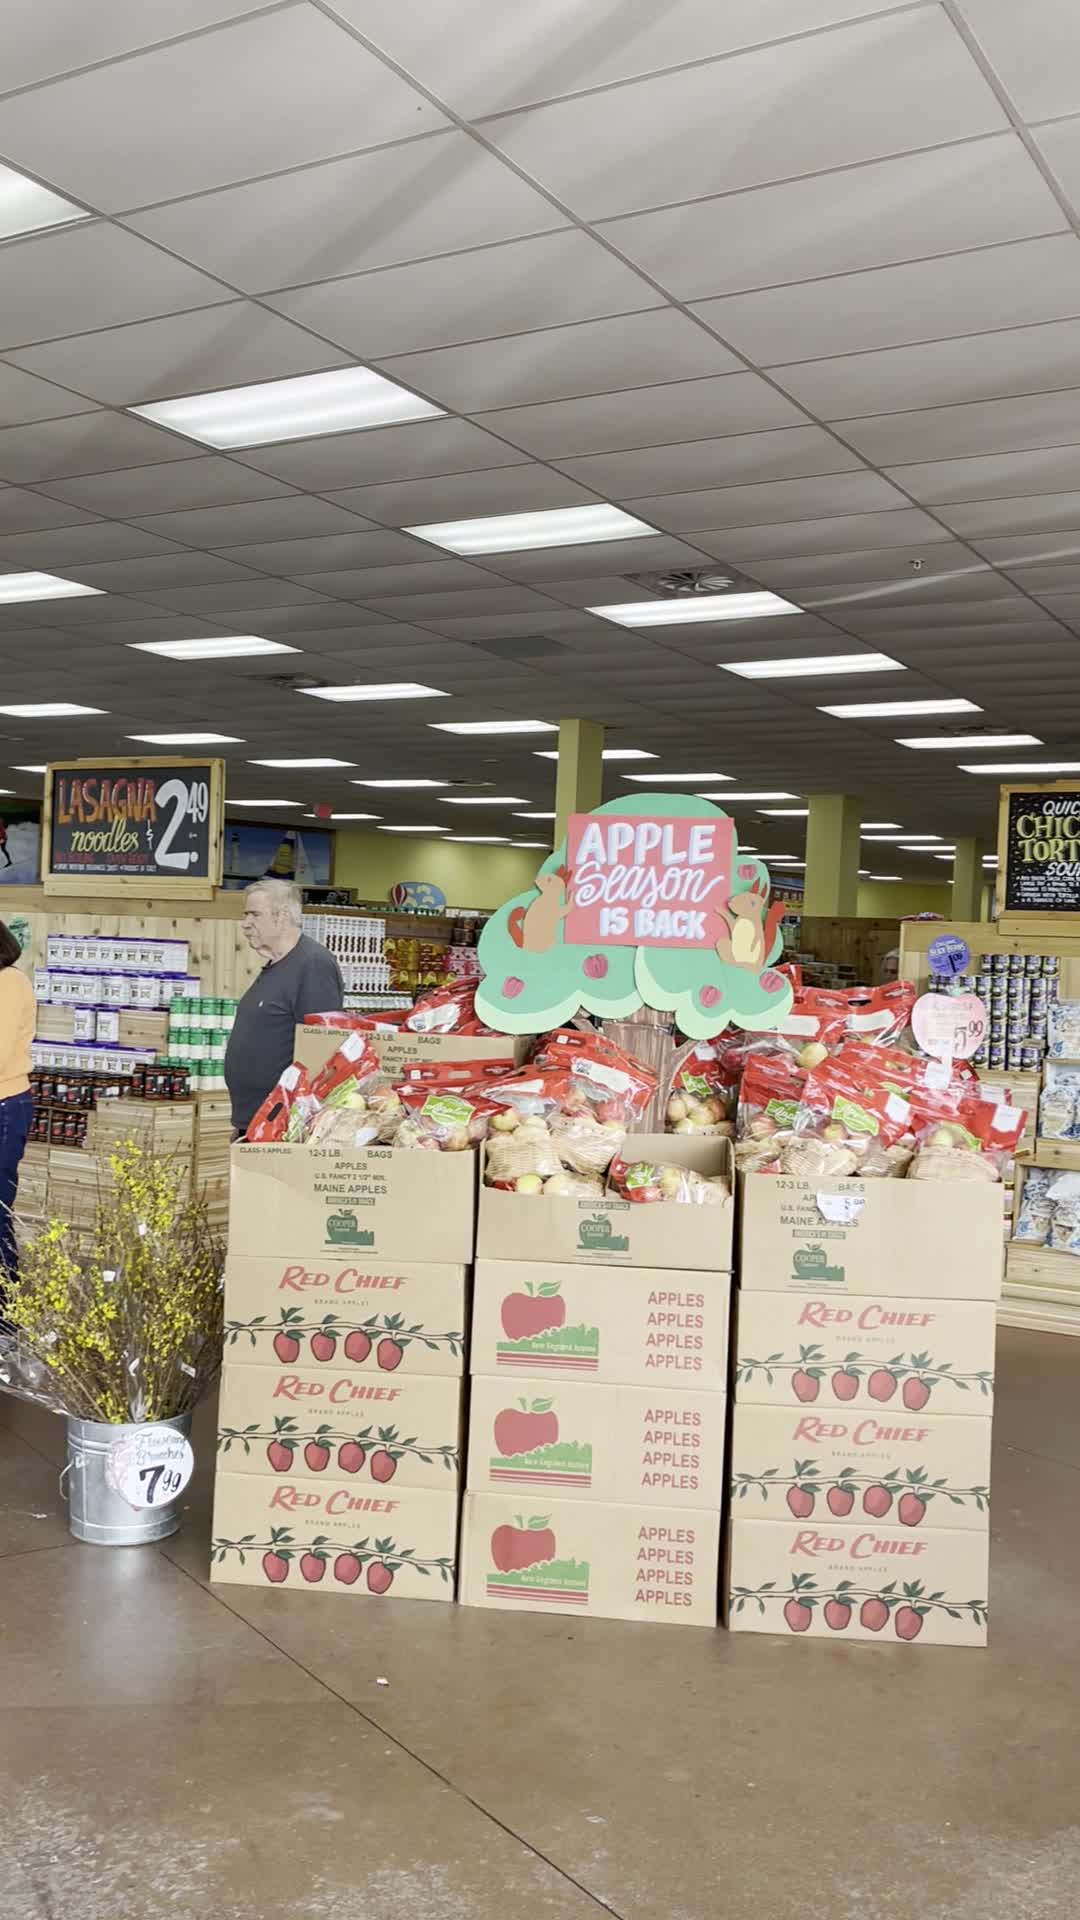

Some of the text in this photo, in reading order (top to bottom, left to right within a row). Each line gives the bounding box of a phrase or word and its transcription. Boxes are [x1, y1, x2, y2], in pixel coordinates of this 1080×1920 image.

[58, 778, 157, 823] LASAGNA
[71, 814, 139, 852] noodles
[1016, 814, 1080, 838] CHIC
[575, 822, 716, 865] APPLE
[574, 860, 725, 907] Season
[600, 906, 707, 940] IS BACK
[417, 1036, 441, 1045] BAGS
[387, 1046, 418, 1055] APPLES
[367, 1150, 393, 1159] BAGS
[334, 1162, 368, 1170] APPLES
[313, 1183, 388, 1194] MAINE APPLES
[780, 1215, 814, 1226] MAINE
[278, 1265, 409, 1293] RED CHIEF
[648, 1291, 705, 1308] APPLES
[647, 1311, 704, 1329] APPLES
[797, 1301, 936, 1330] RED CHIEF
[646, 1333, 703, 1350] APPLES
[645, 1353, 703, 1370] APPLES
[272, 1374, 404, 1404] RED CHIEF
[643, 1409, 702, 1426] APPLES
[643, 1430, 701, 1448] APPLES
[791, 1416, 931, 1446] RED CHIEF
[642, 1451, 700, 1469] APPLES
[641, 1472, 699, 1490] APPLES
[268, 1485, 401, 1515] RED CHIEF
[638, 1526, 695, 1544] APPLES
[789, 1530, 929, 1560] RED CHIEF
[637, 1547, 694, 1565] APPLES
[636, 1568, 693, 1586] APPLES
[635, 1589, 693, 1607] APPLES
